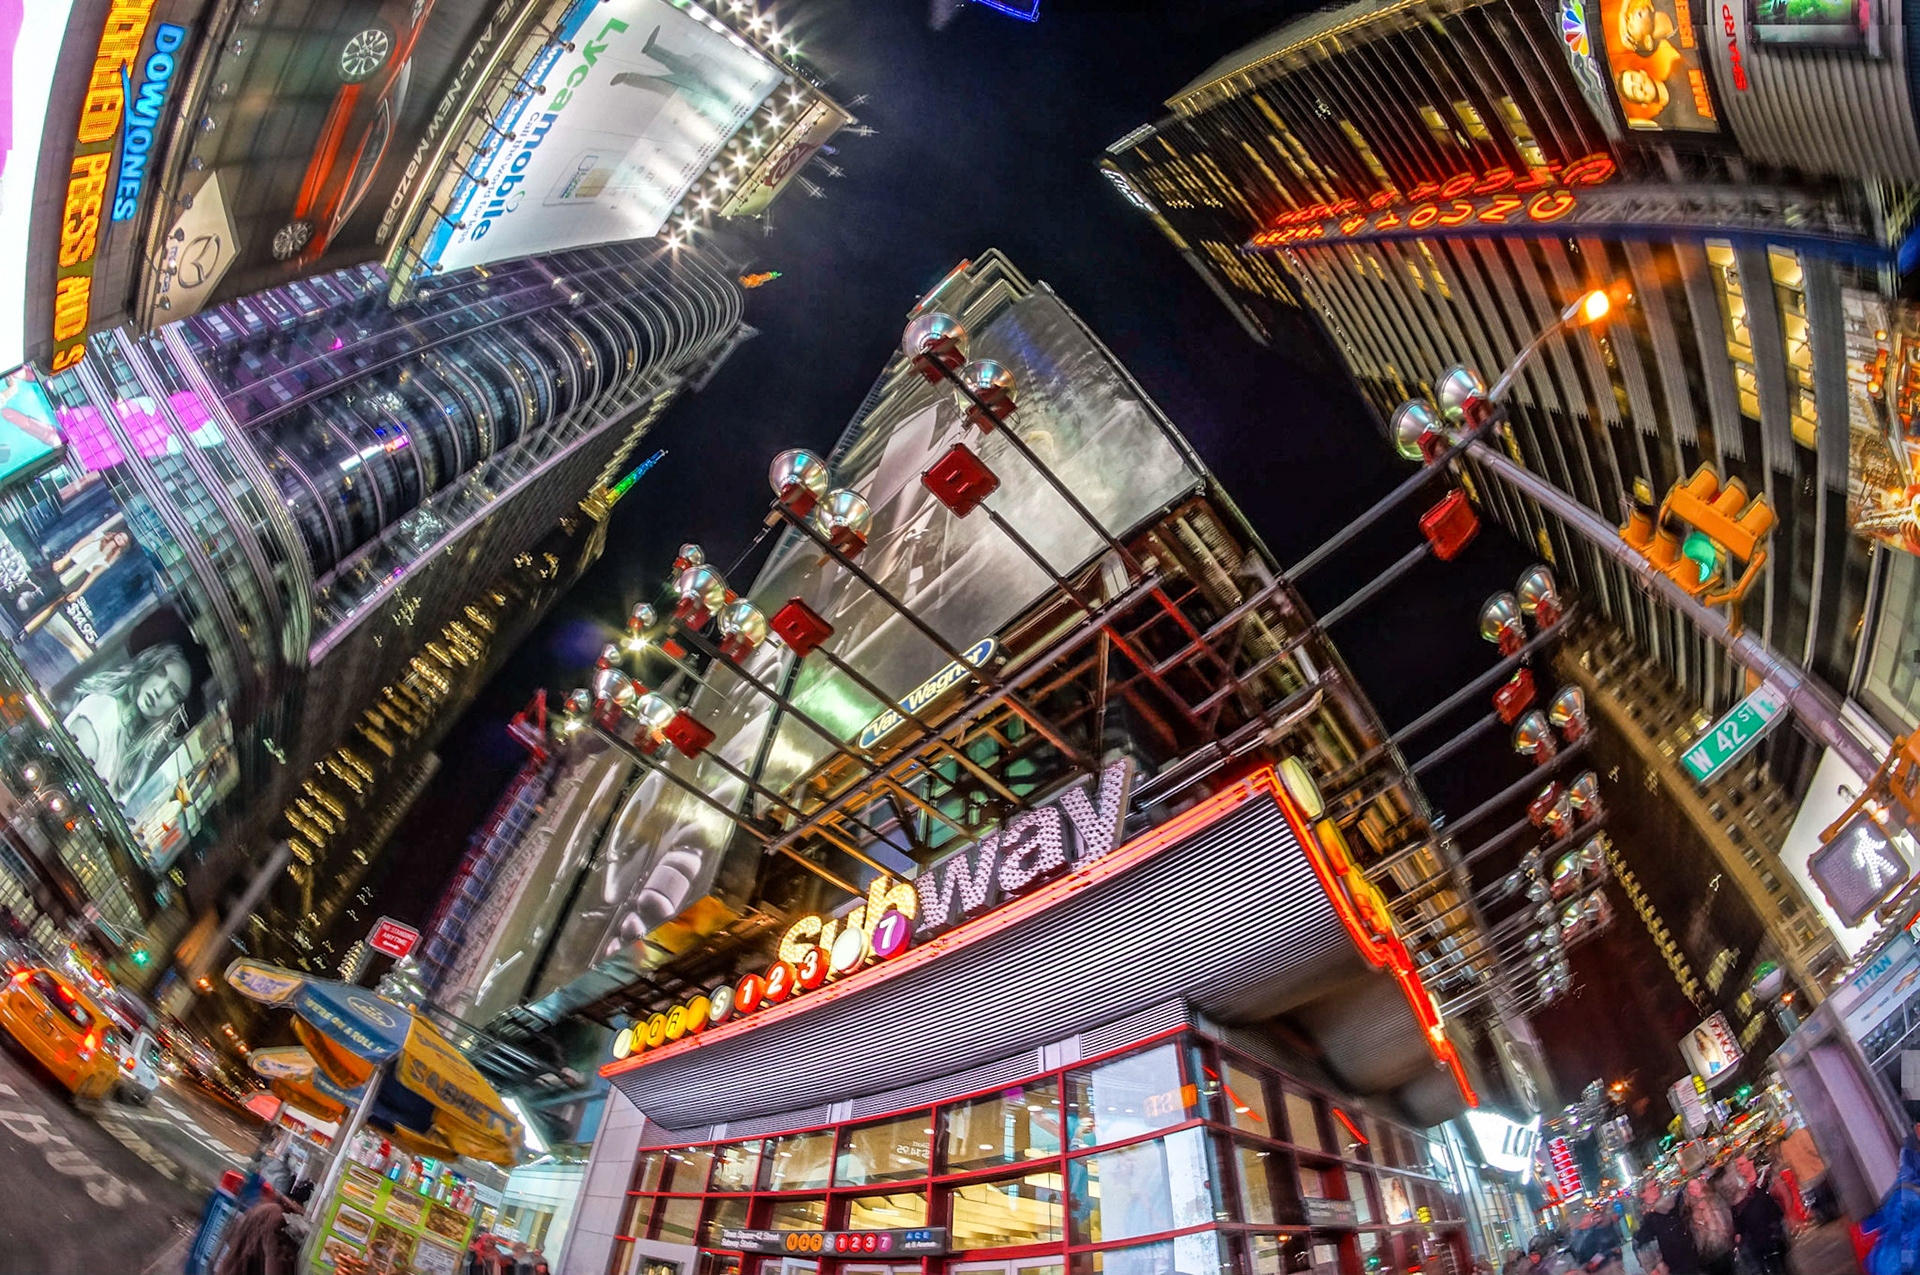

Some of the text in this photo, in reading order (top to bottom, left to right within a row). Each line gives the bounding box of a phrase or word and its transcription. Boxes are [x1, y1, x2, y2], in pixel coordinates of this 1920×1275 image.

[1723, 4, 1748, 90] SHARP
[468, 17, 628, 243] Lycamobile
[1688, 705, 1754, 773] W 42 ST
[1852, 954, 1894, 993] TITAN
[408, 1057, 517, 1138] SABRETT
